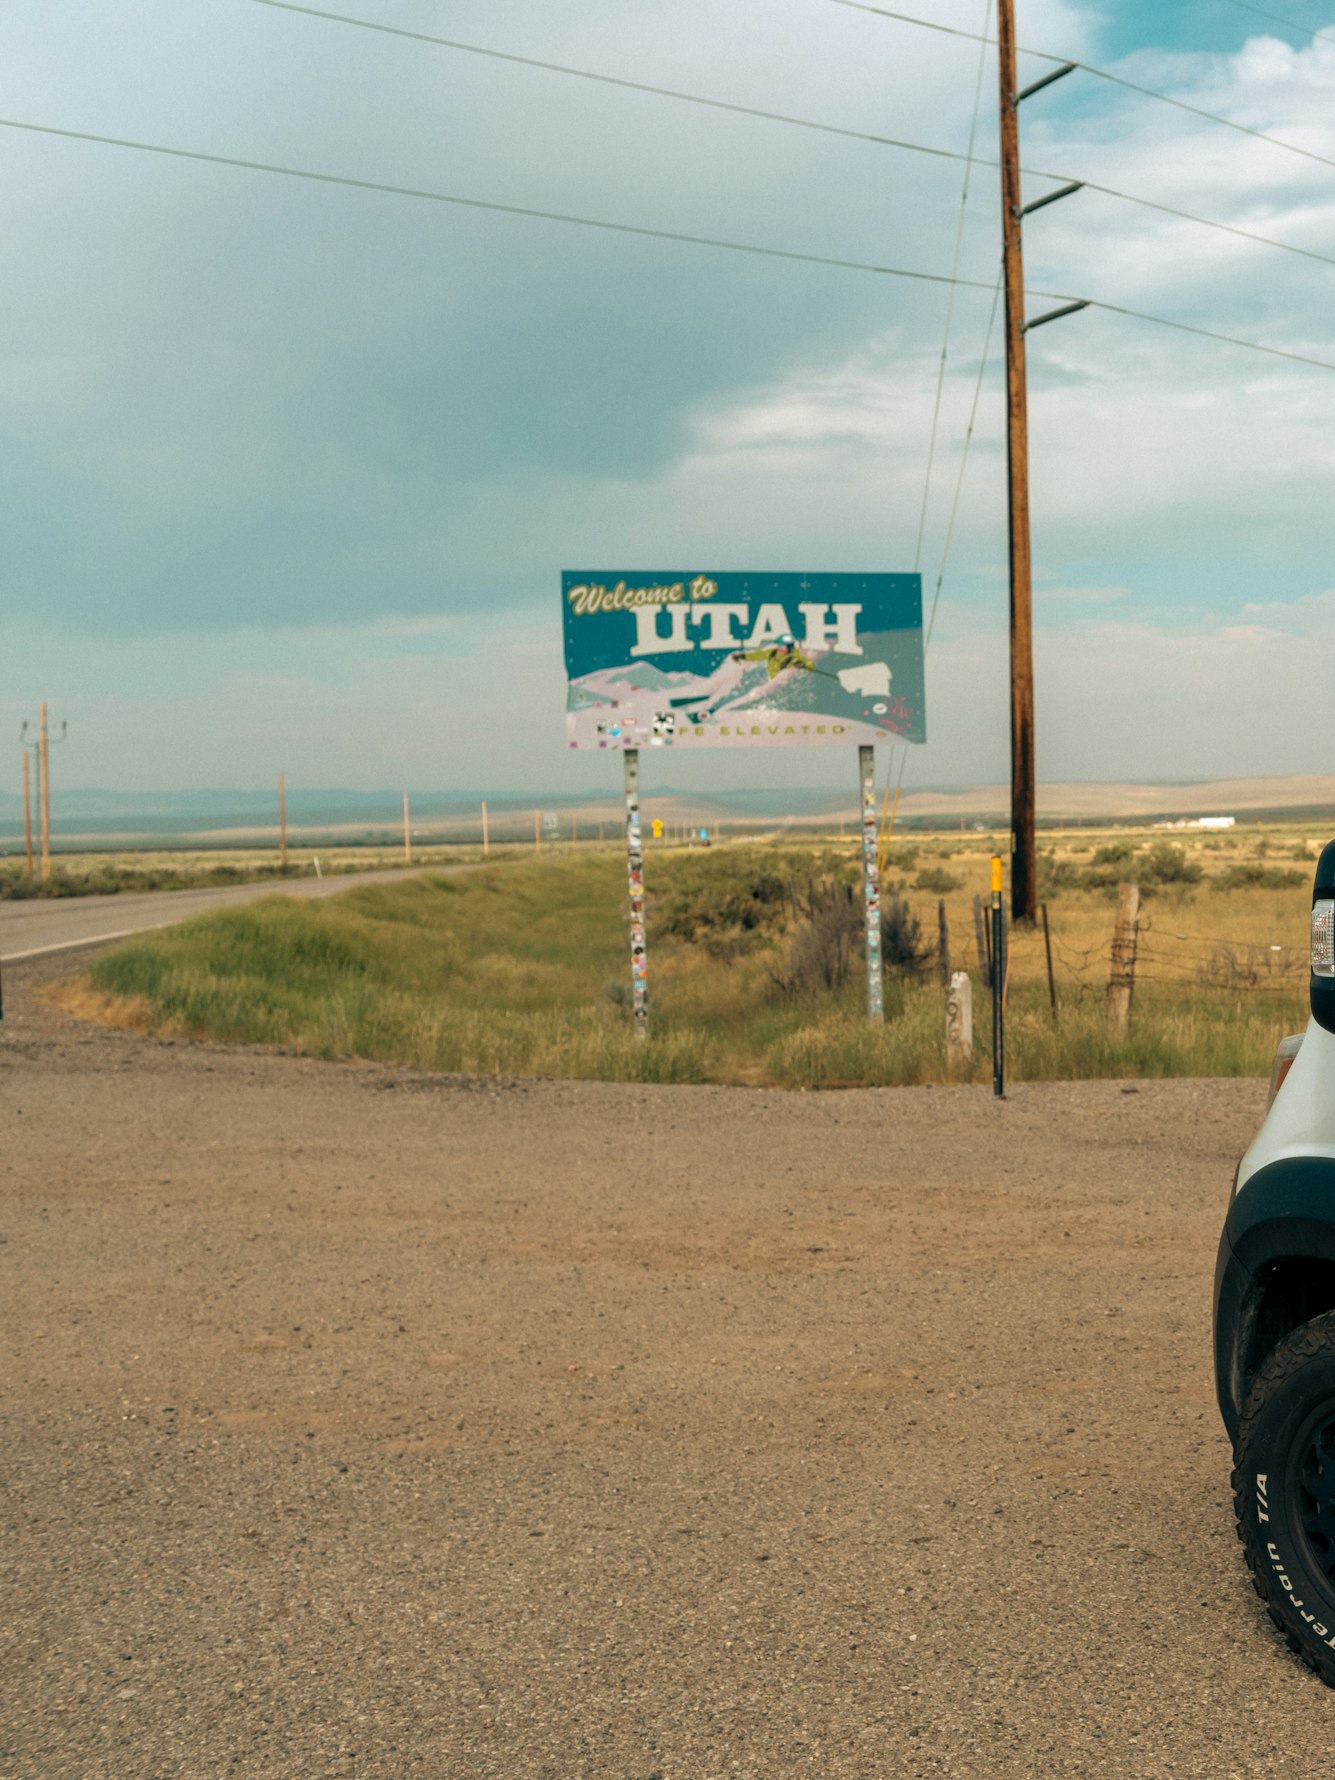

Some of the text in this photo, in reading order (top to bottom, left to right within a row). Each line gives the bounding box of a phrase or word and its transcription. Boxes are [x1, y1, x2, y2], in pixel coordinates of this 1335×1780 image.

[568, 575, 717, 615] Welcome to
[629, 602, 863, 656] UTAH
[720, 725, 846, 736] ELEVATED
[1256, 1473, 1269, 1524] T/A
